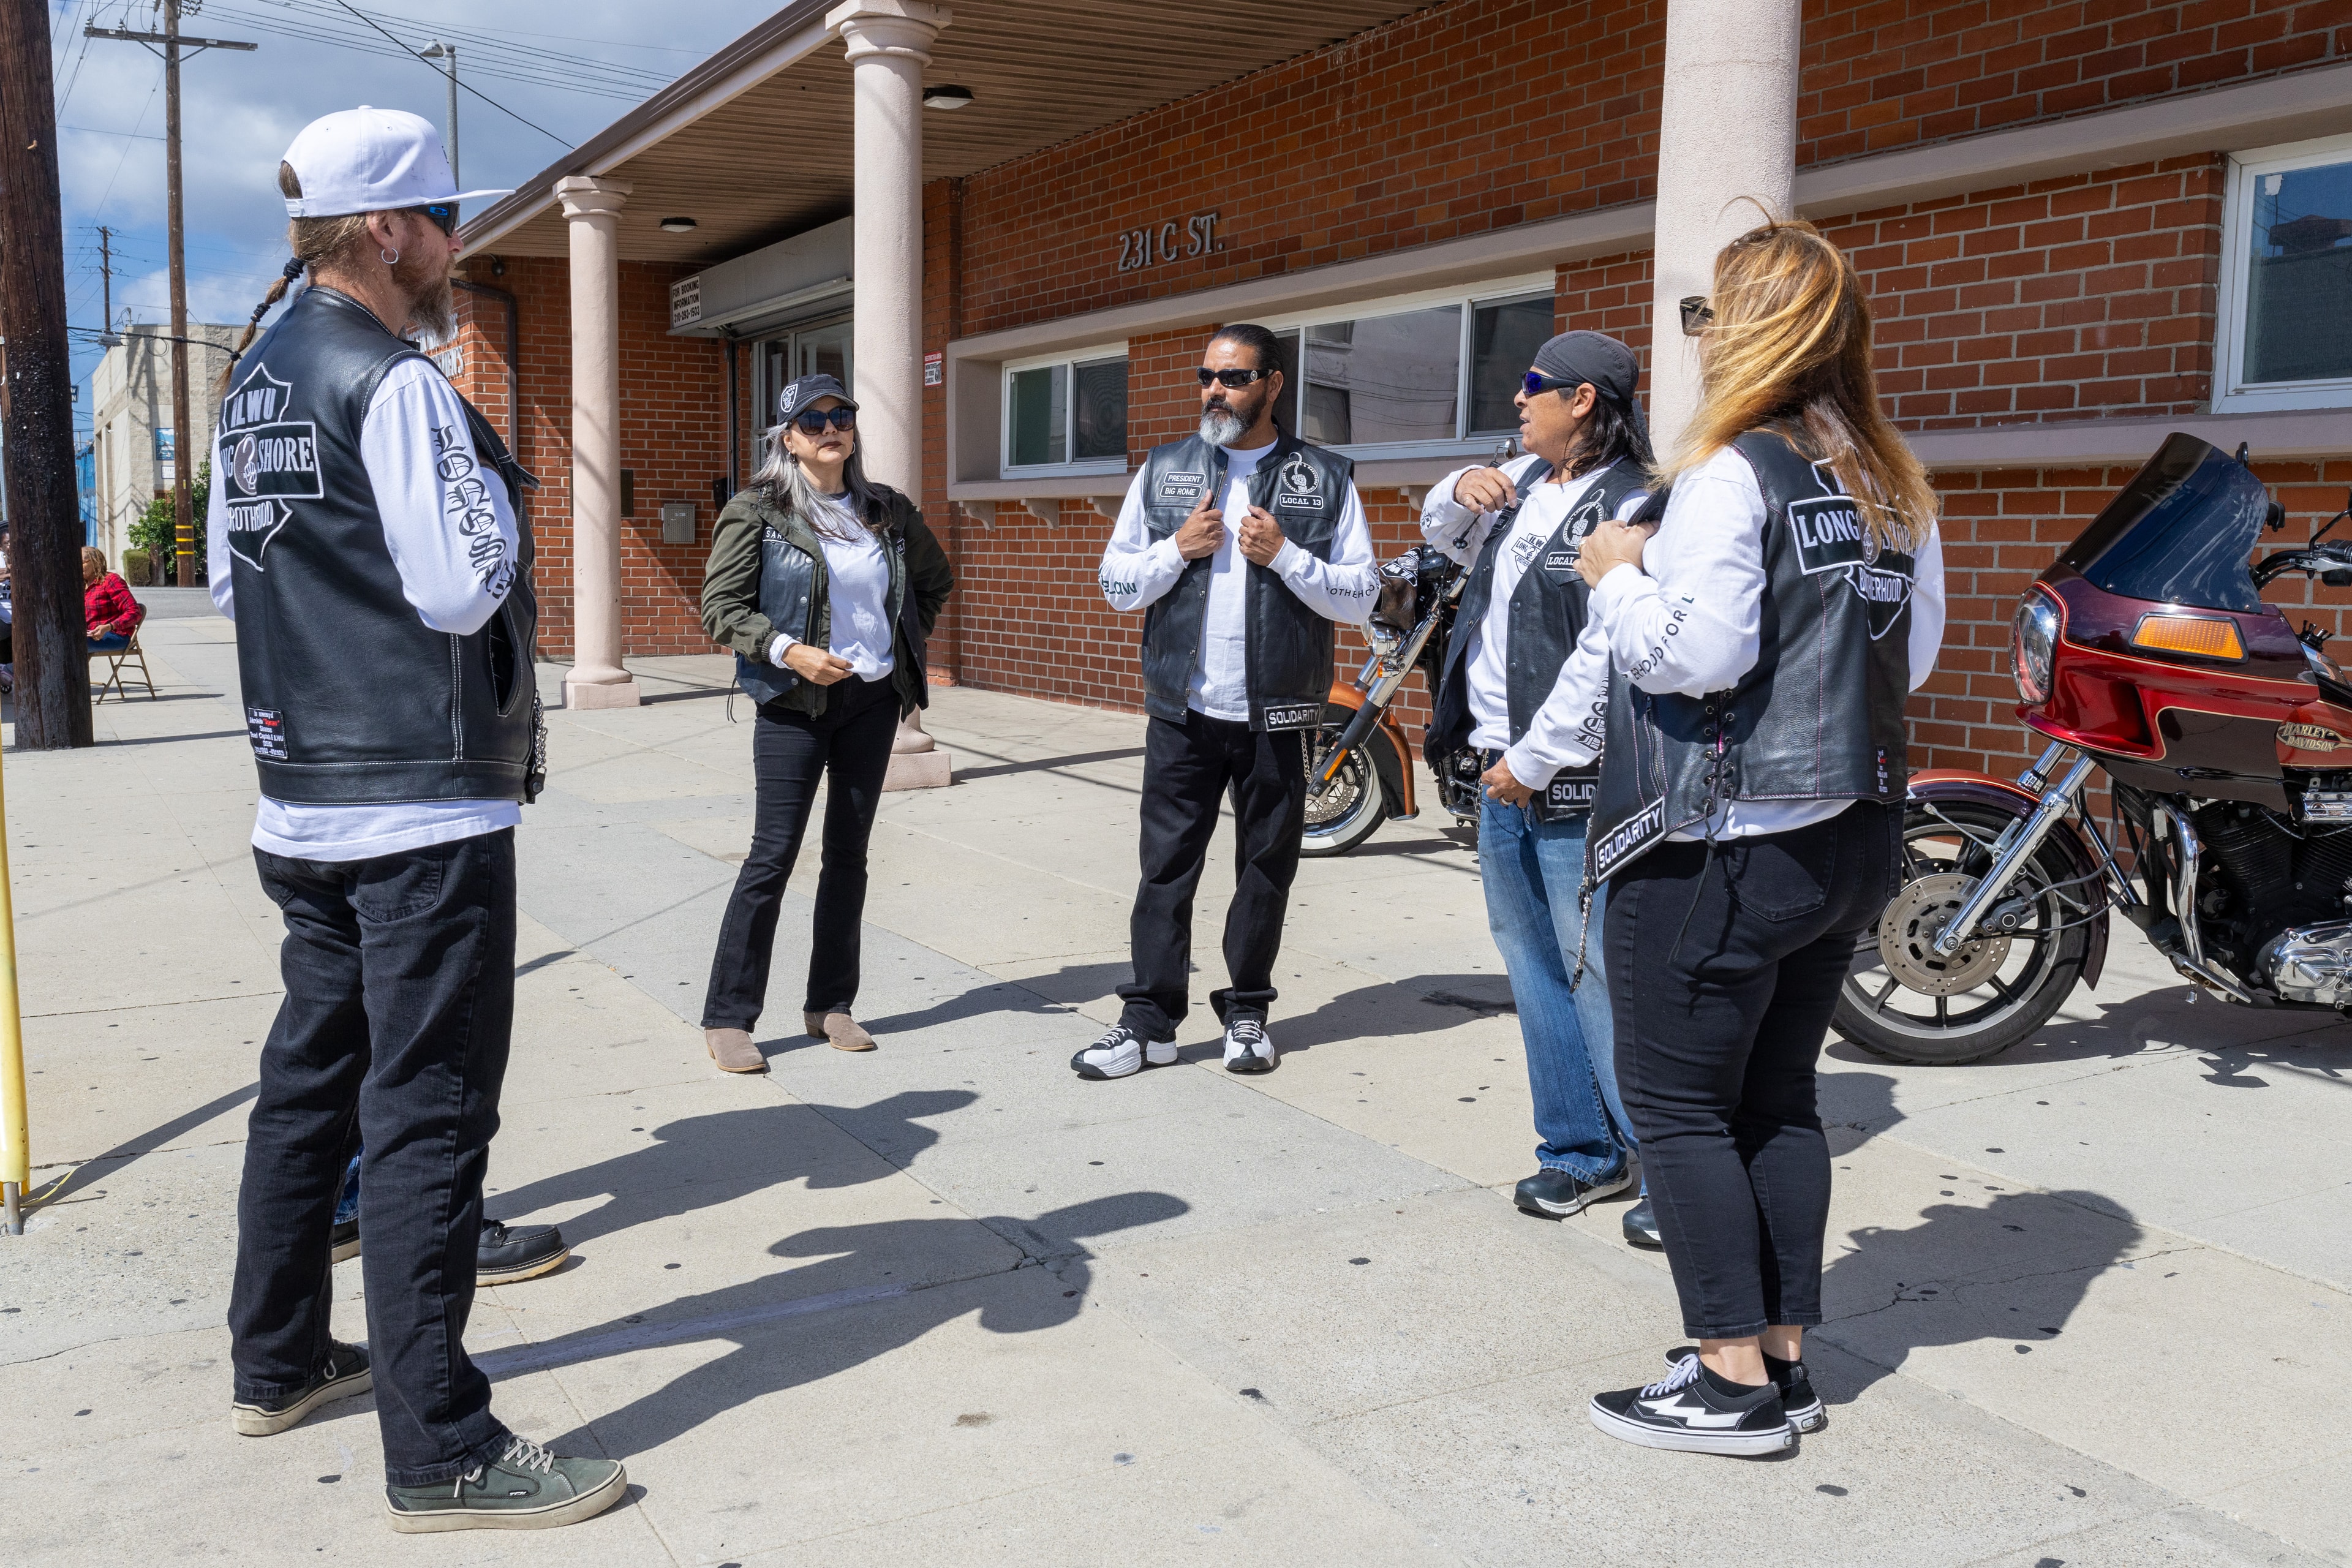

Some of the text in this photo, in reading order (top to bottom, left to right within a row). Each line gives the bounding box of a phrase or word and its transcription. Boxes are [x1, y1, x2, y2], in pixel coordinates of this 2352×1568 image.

[1118, 212, 1223, 272] 231 C ST.
[681, 279, 699, 294] BOOKING
[674, 293, 699, 311] INFORMATION
[674, 305, 700, 323] 310-293-1503
[230, 388, 276, 428] ILWU
[257, 437, 315, 473] SHORE
[1167, 475, 1202, 483] PRESIDENT
[1281, 496, 1309, 505] LOCAL
[1796, 510, 1861, 549] LONG
[1515, 540, 1529, 552] LONG
[1547, 556, 1575, 565] LOCAL
[1268, 709, 1319, 725] SOLIDARITY
[2286, 735, 2335, 752] DAVIDSON
[1552, 783, 1594, 801] SOLID
[1598, 807, 1661, 869] SOLIDARITY
